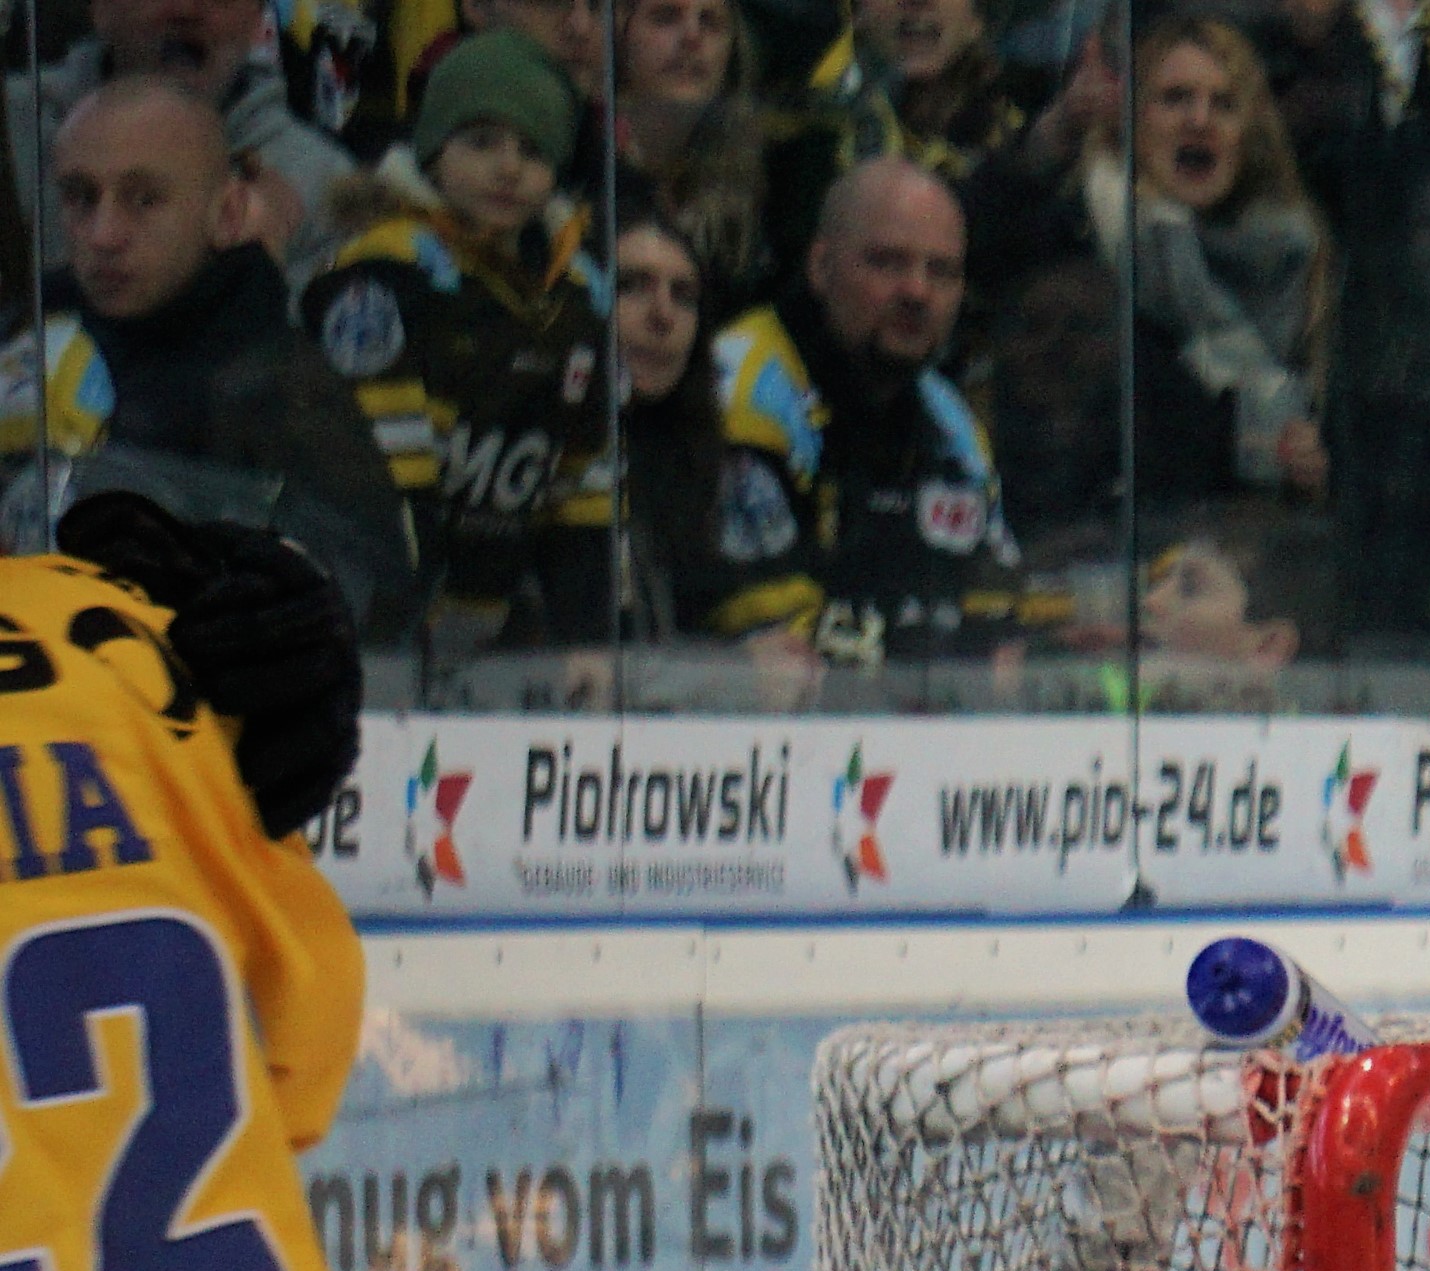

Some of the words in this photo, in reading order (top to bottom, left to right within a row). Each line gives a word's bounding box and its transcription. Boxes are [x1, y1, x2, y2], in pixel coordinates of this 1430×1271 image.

[444, 423, 564, 512] MG
[522, 738, 790, 844] Piotrowski
[940, 758, 1282, 875] www.pio-24.de
[689, 1109, 798, 1268] Eis
